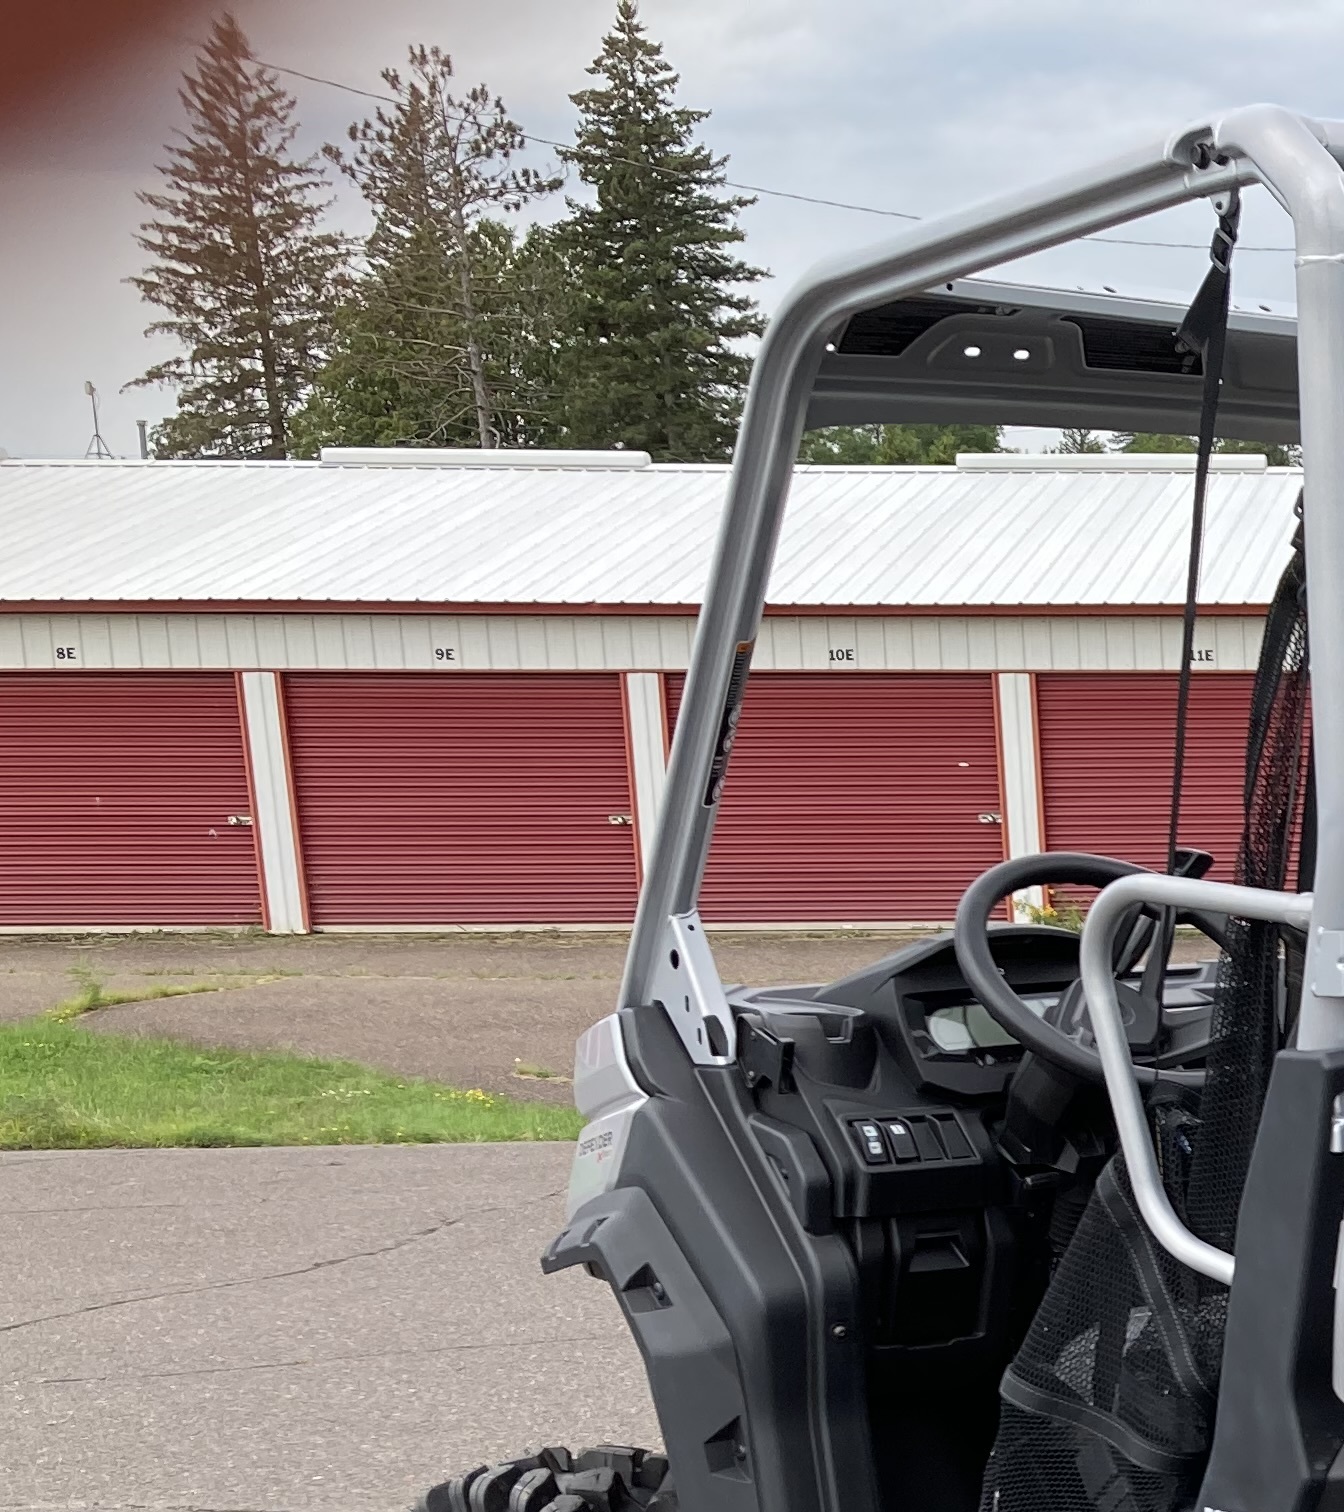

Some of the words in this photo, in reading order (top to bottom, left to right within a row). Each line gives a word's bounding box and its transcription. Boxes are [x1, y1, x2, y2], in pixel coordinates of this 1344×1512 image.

[56, 647, 76, 660] 8E
[435, 648, 455, 661] 9E
[829, 648, 854, 661] 10E
